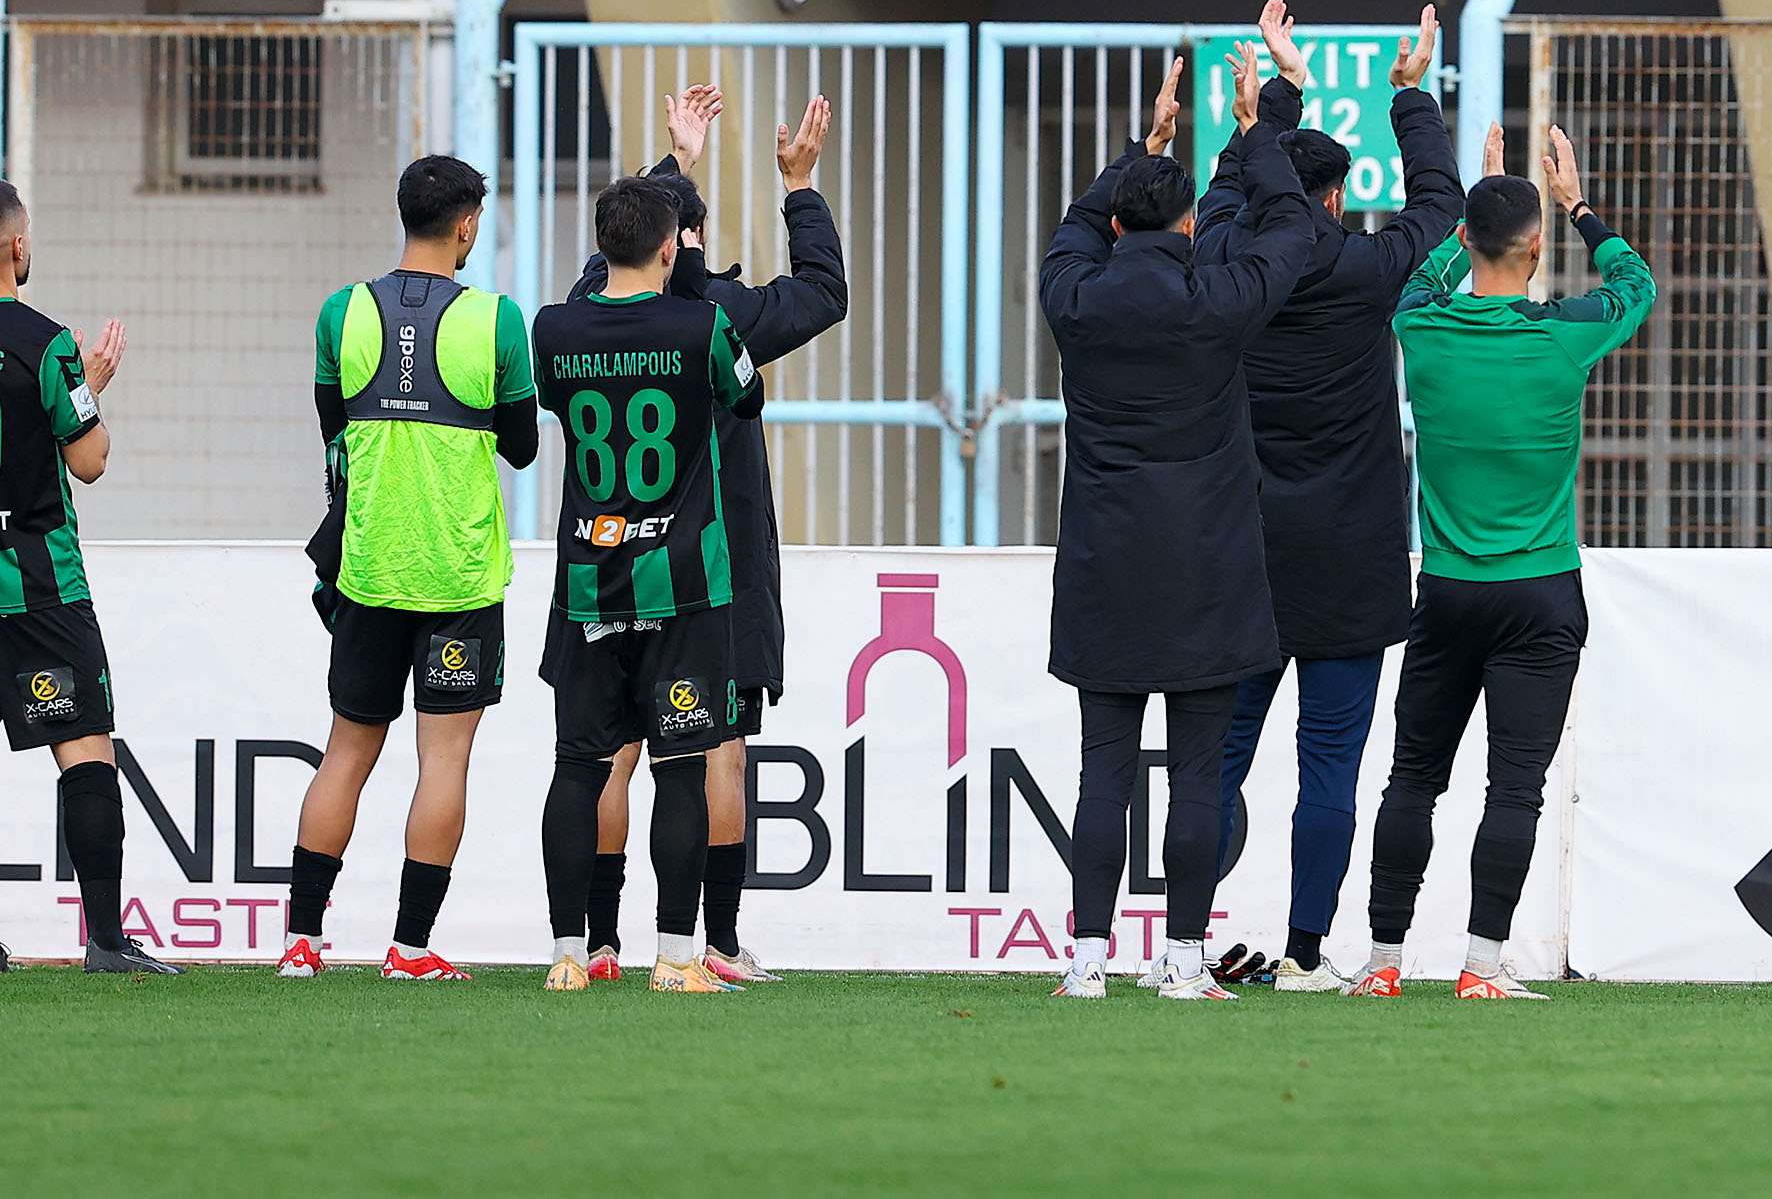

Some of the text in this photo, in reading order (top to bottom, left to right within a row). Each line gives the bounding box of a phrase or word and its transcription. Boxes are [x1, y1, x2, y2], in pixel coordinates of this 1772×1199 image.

[399, 325, 416, 393] gpexe
[553, 350, 682, 379] CHARALAMPOUS
[380, 398, 429, 411] THE POWER TRACKER
[568, 388, 676, 502] 88
[428, 667, 476, 681] X-CARS
[428, 678, 448, 686] AUTO
[26, 698, 73, 714] X-CARS
[661, 708, 709, 725] X-CARS
[664, 723, 685, 731] AUTO
